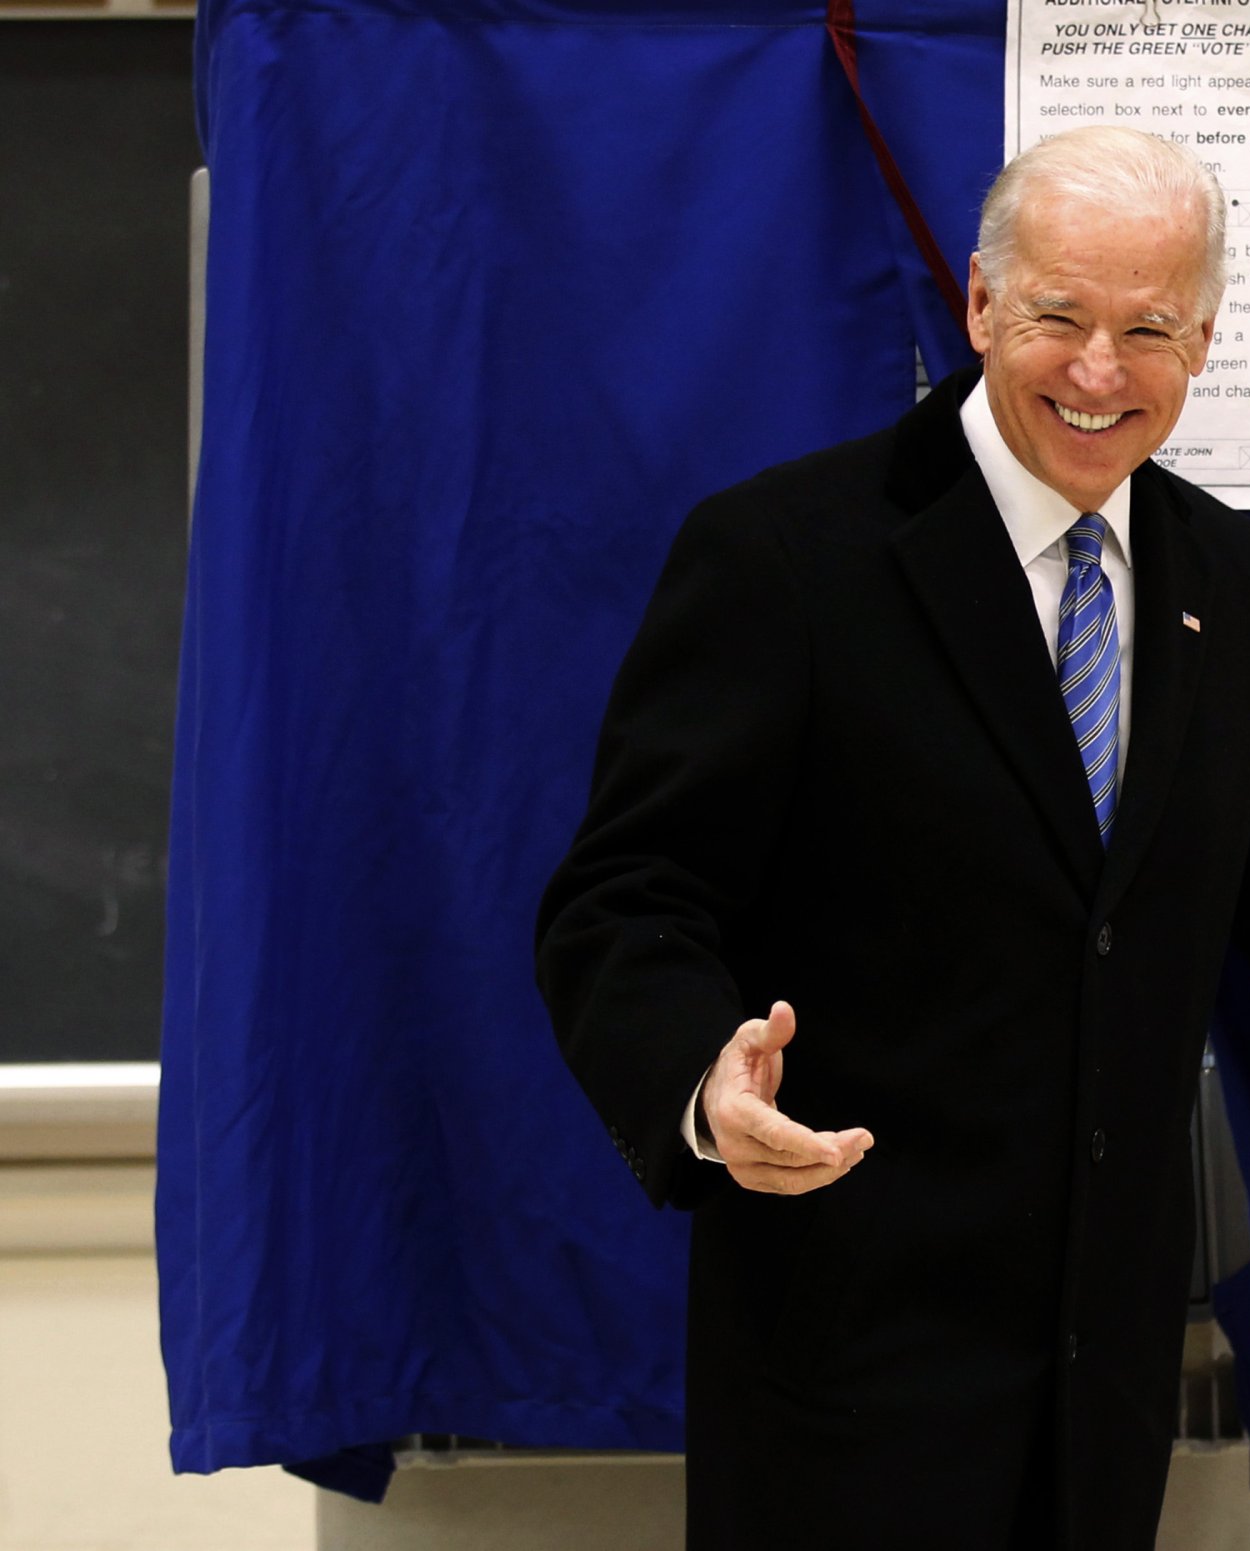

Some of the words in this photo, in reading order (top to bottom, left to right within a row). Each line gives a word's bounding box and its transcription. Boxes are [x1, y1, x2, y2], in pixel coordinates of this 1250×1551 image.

[1055, 24, 1089, 37] YOU
[1093, 24, 1140, 37] ONLY
[1143, 24, 1178, 37] GET
[1180, 24, 1218, 39] ONE
[1041, 43, 1086, 55] PUSH
[1092, 43, 1125, 55] THE
[1128, 43, 1187, 55] GREEN
[1040, 74, 1080, 88] Make
[1087, 77, 1119, 88] sure
[1125, 77, 1134, 88] a
[1141, 75, 1165, 88] red
[1171, 75, 1201, 91] light
[1040, 103, 1104, 116] selection
[1115, 103, 1141, 116] box
[1152, 104, 1183, 116] next
[1193, 104, 1207, 116] to
[1170, 131, 1190, 144] for
[1196, 131, 1246, 144] before
[1234, 331, 1244, 342] a
[1206, 359, 1248, 373] green
[1192, 385, 1220, 398] and
[1184, 448, 1213, 456] JOHN
